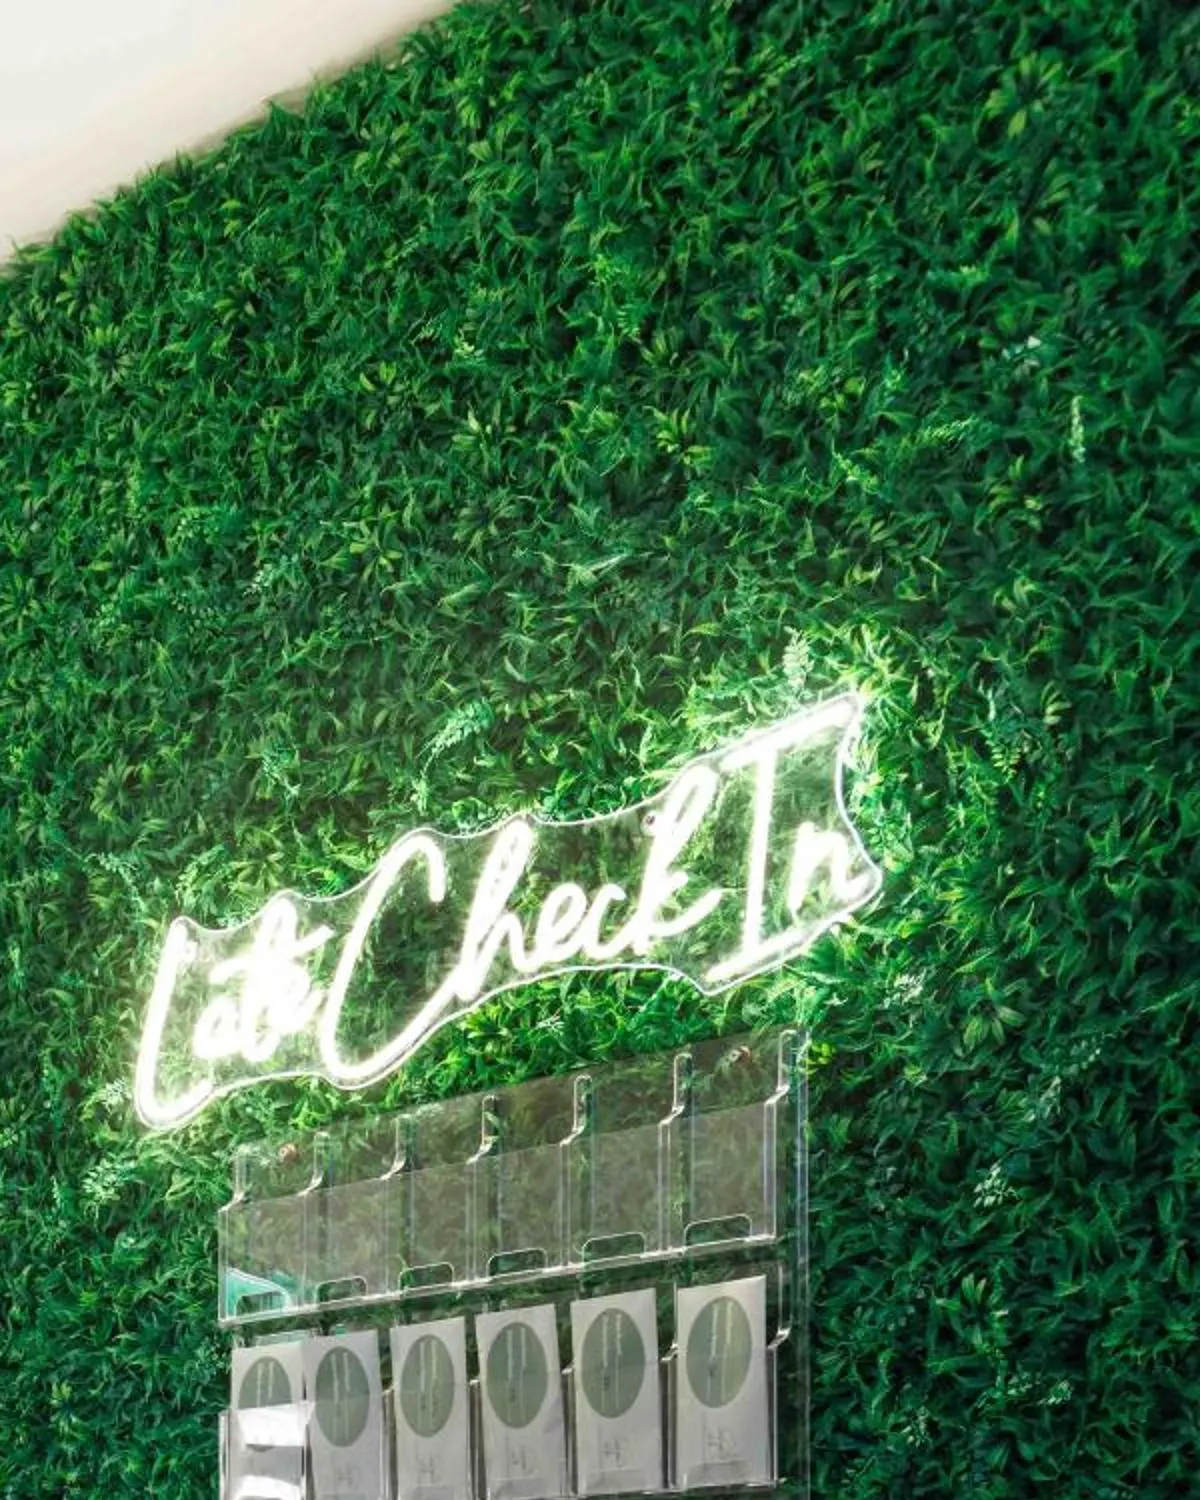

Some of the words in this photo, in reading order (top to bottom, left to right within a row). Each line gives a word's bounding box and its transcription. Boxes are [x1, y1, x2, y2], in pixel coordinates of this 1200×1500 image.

[136, 898, 332, 1127] Late
[320, 762, 723, 1078] Check
[704, 692, 872, 985] In
